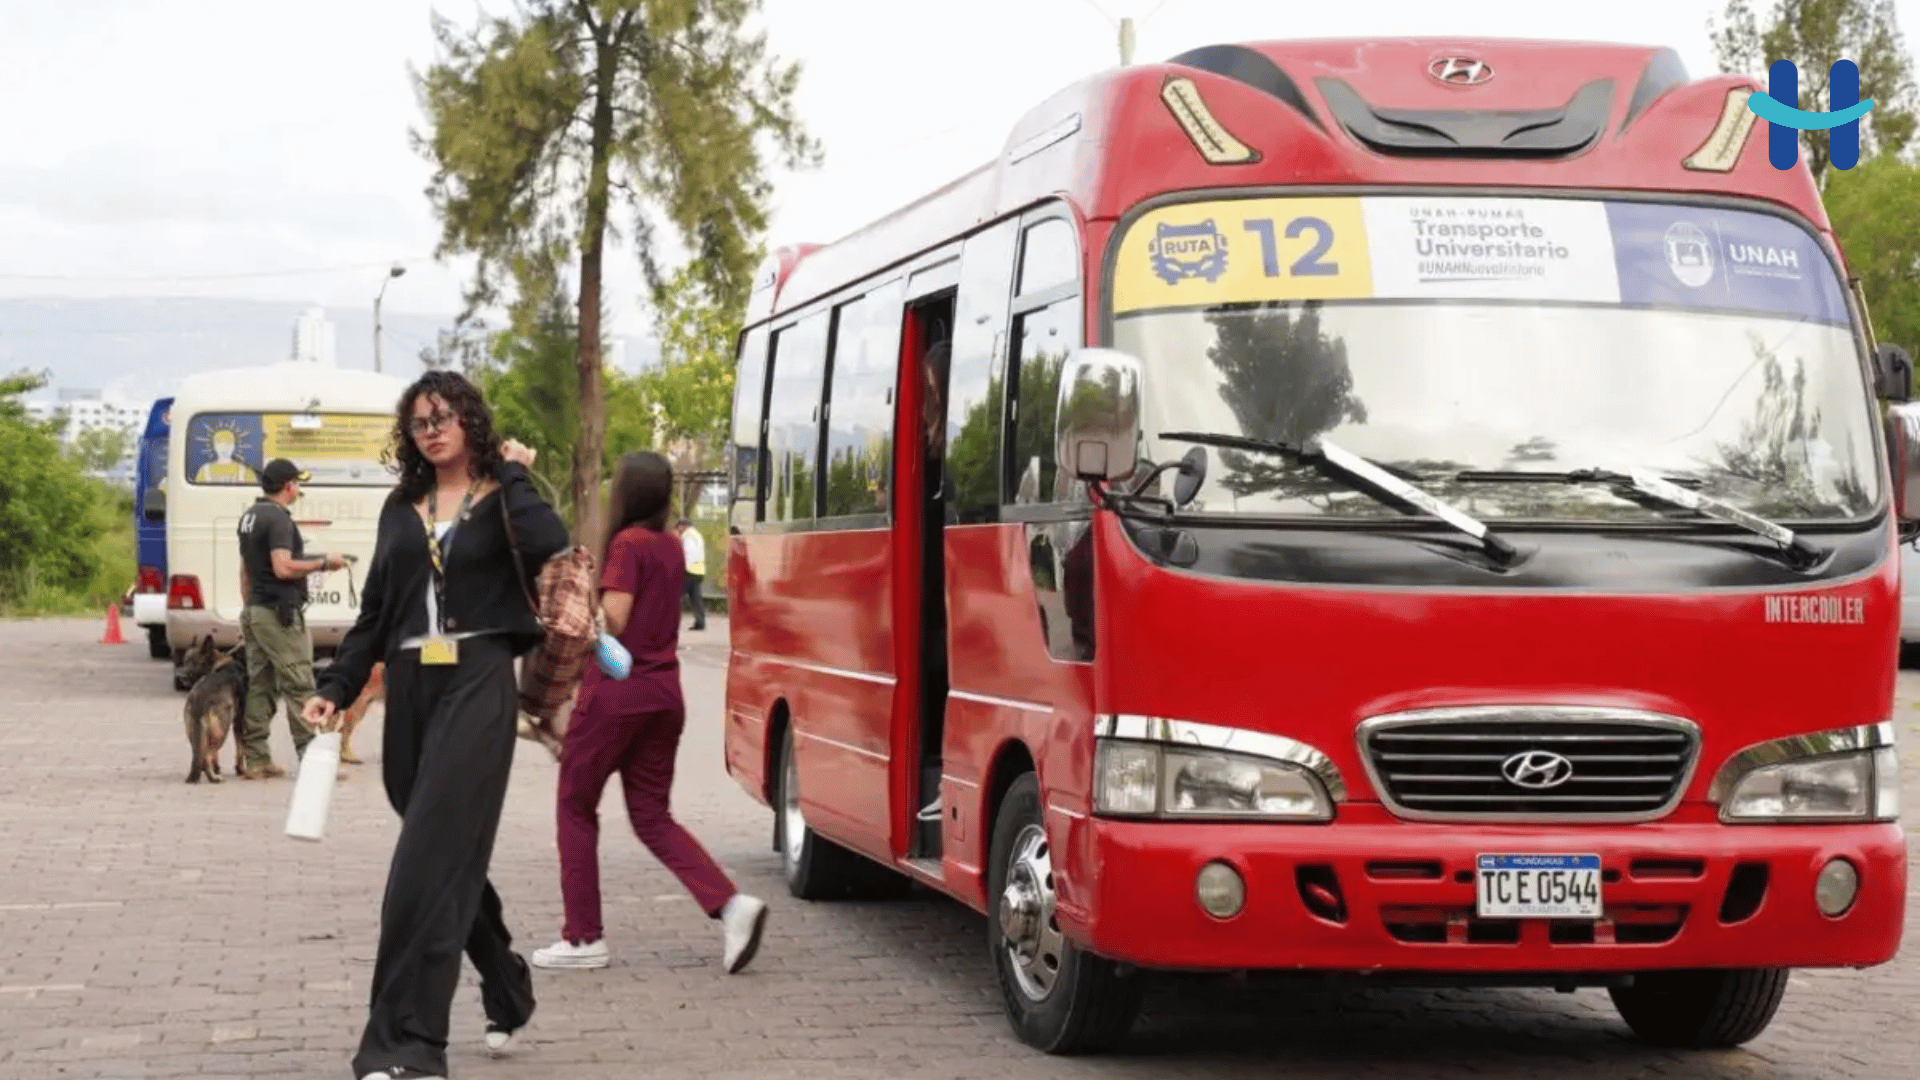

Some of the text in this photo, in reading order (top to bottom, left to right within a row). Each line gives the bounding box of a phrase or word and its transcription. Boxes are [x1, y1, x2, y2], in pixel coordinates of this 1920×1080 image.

[1411, 219, 1544, 242] Transporte
[1163, 215, 1340, 278] RUTA 12
[1415, 238, 1571, 260] Universitario
[1728, 242, 1799, 269] UNAH
[1764, 595, 1866, 625] INTERCOOLER
